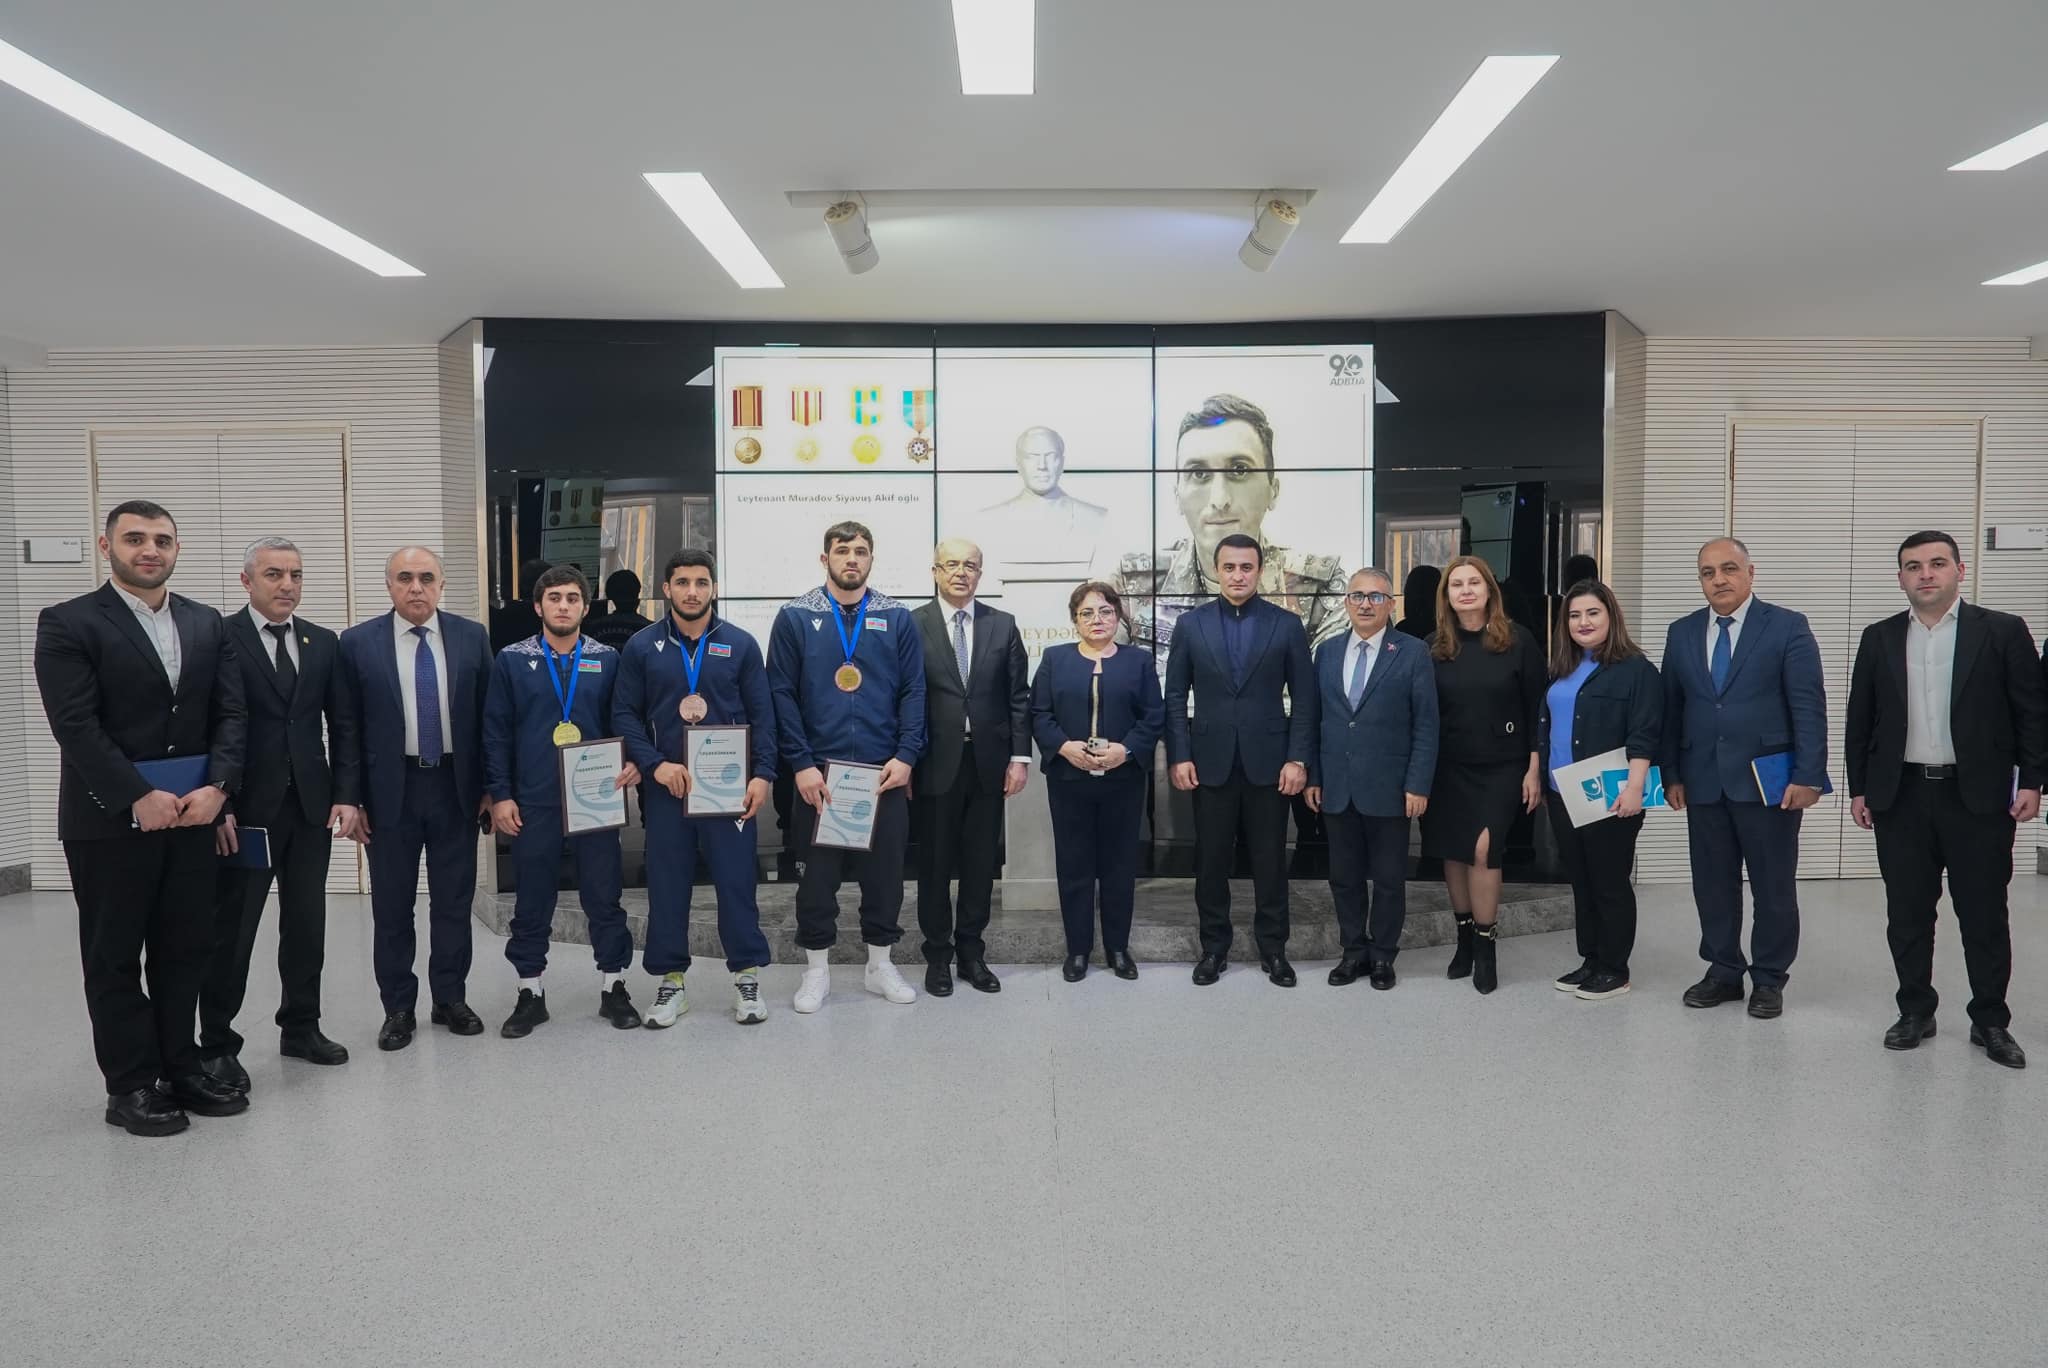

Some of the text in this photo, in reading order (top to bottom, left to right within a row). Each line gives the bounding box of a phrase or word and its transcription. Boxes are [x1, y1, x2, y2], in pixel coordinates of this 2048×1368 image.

[737, 495, 785, 504] Leytenant
[788, 494, 832, 502] Muradov
[875, 493, 895, 502] Akif
[1023, 628, 1081, 640] EYDƏR
